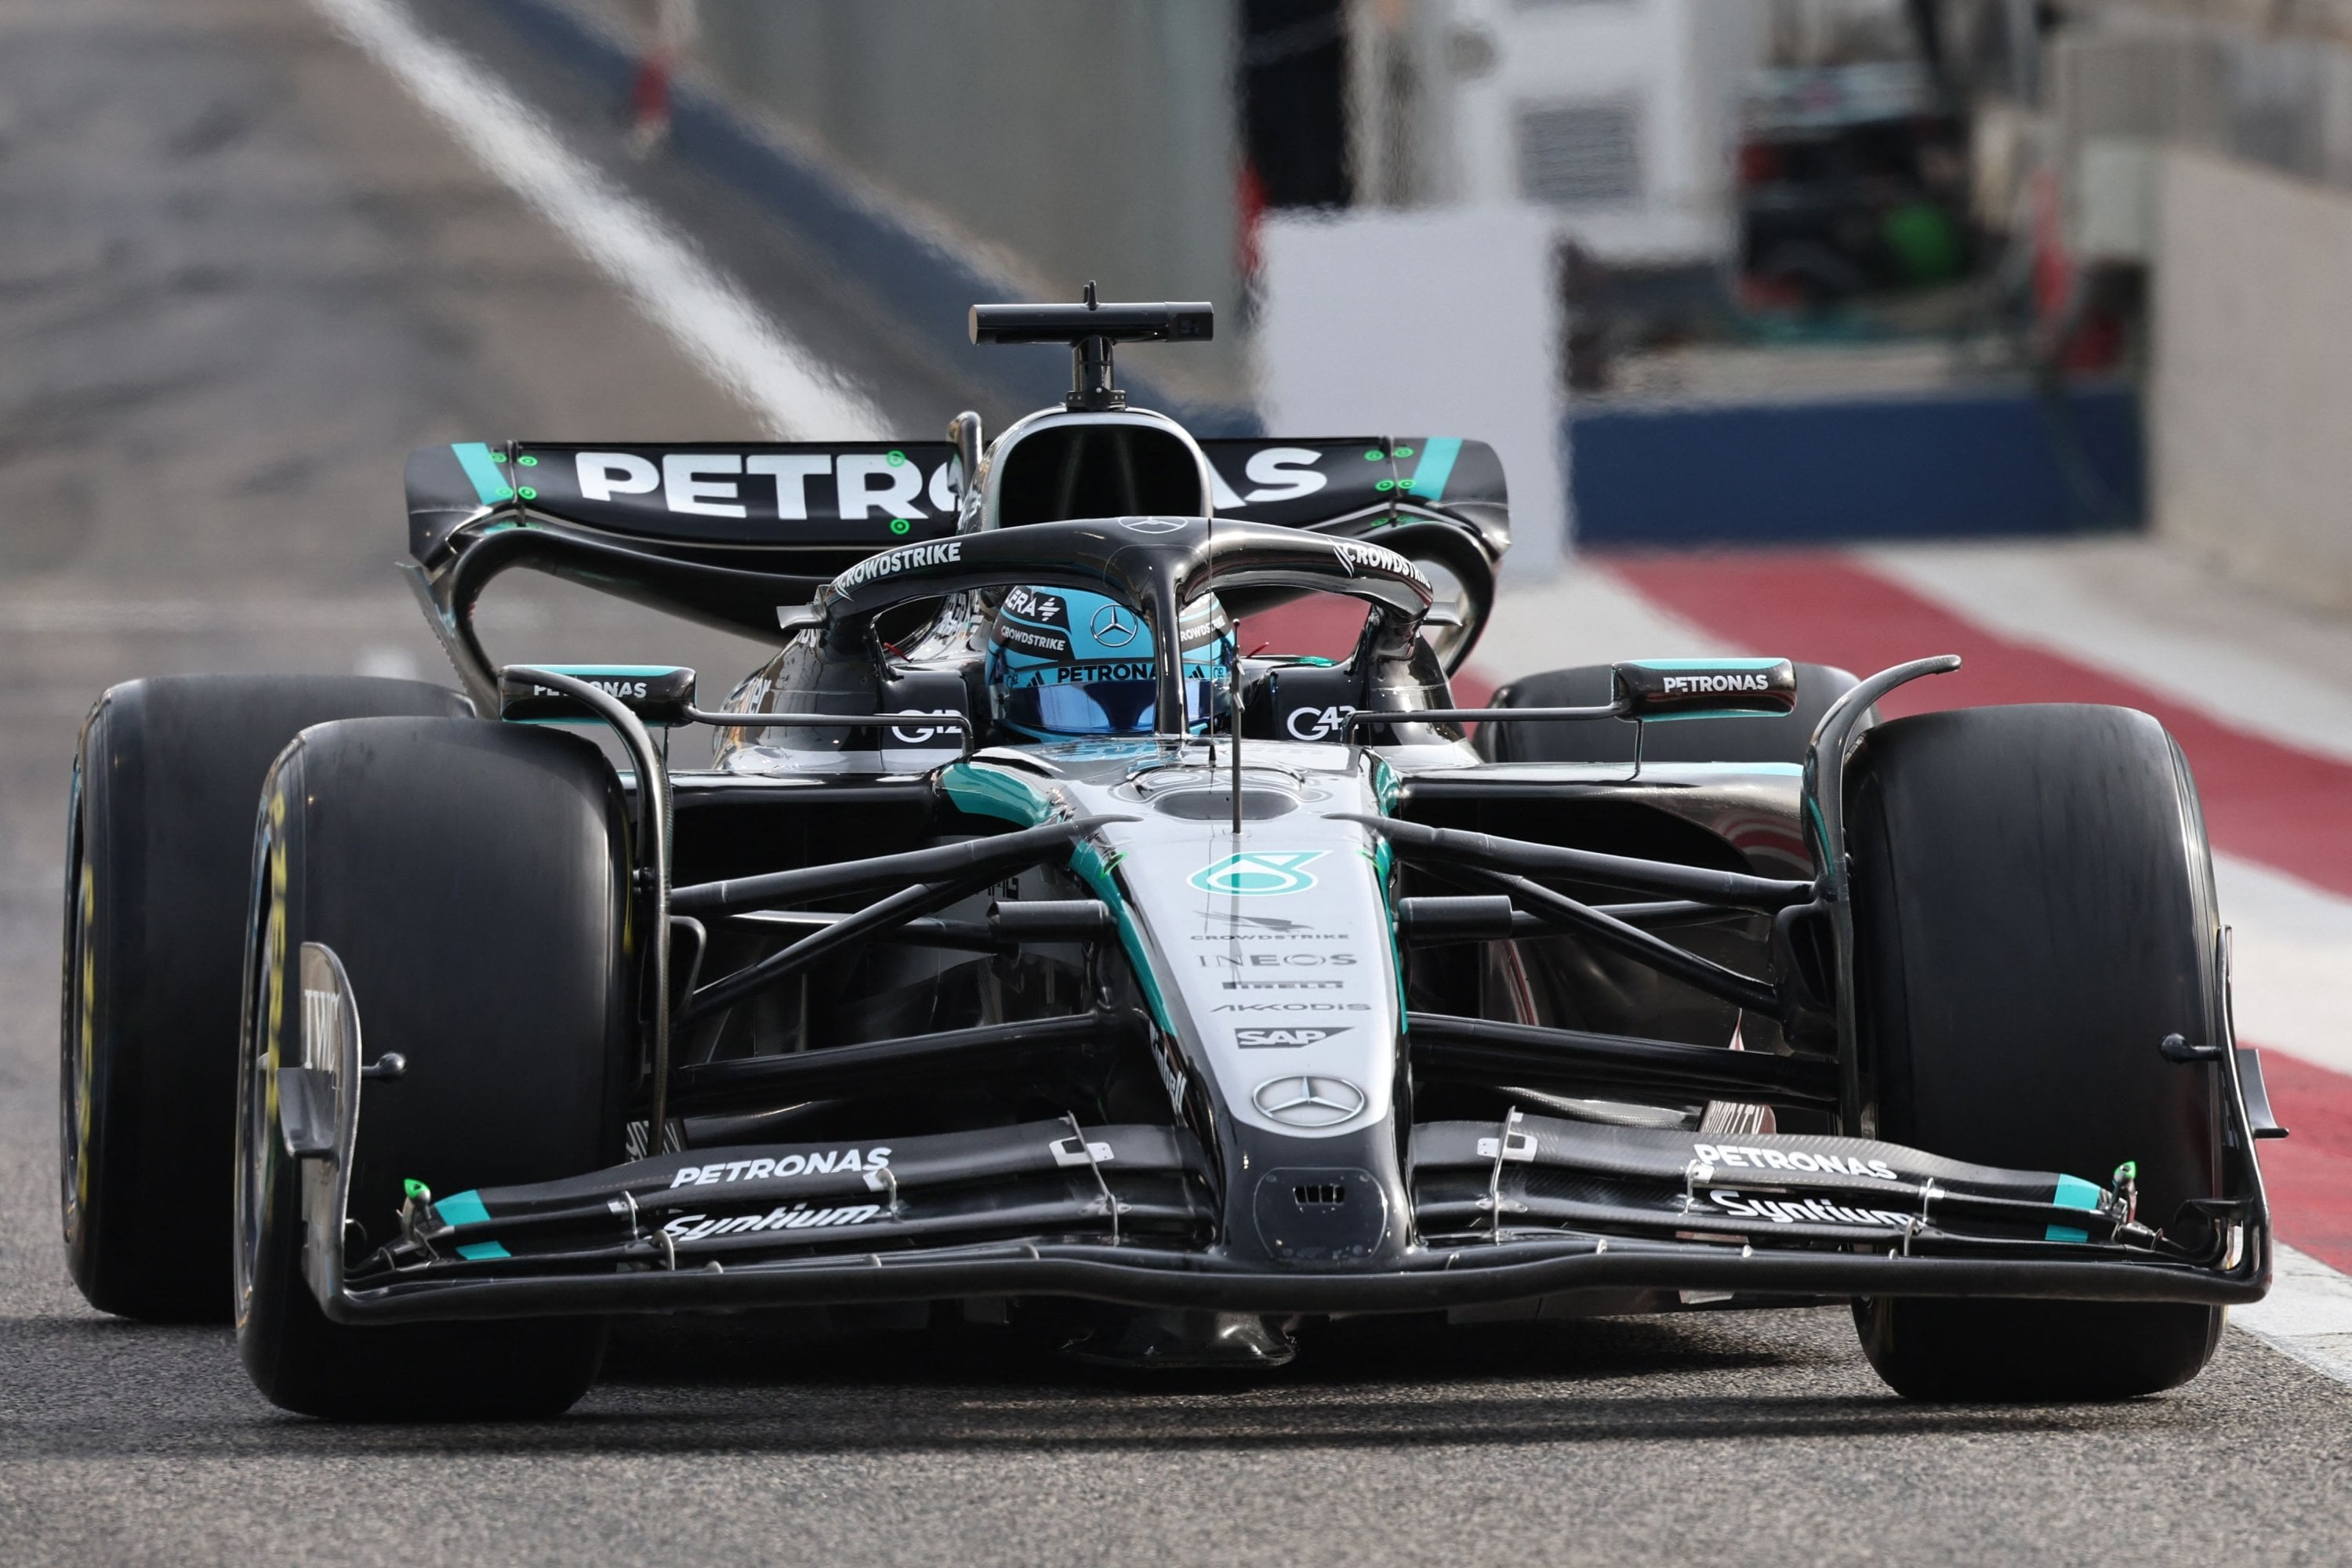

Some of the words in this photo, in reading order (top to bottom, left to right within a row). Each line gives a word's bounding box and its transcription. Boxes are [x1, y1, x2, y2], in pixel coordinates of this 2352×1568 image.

[575, 447, 1327, 518] PETRS
[1001, 626, 1066, 652] CROWDSTRIKE
[1058, 663, 1156, 684] PETRON
[1663, 675, 1769, 693] PETRONAS
[534, 681, 648, 699] PENAS
[1198, 953, 1358, 967] INEOS
[1221, 981, 1344, 990] PIRELLI
[1236, 1029, 1327, 1046] SAP
[670, 1147, 892, 1189] PETRONAS
[1693, 1143, 1897, 1180] PETRONAS
[1710, 1189, 1928, 1228] Syntium
[643, 1203, 880, 1242] Syntium
